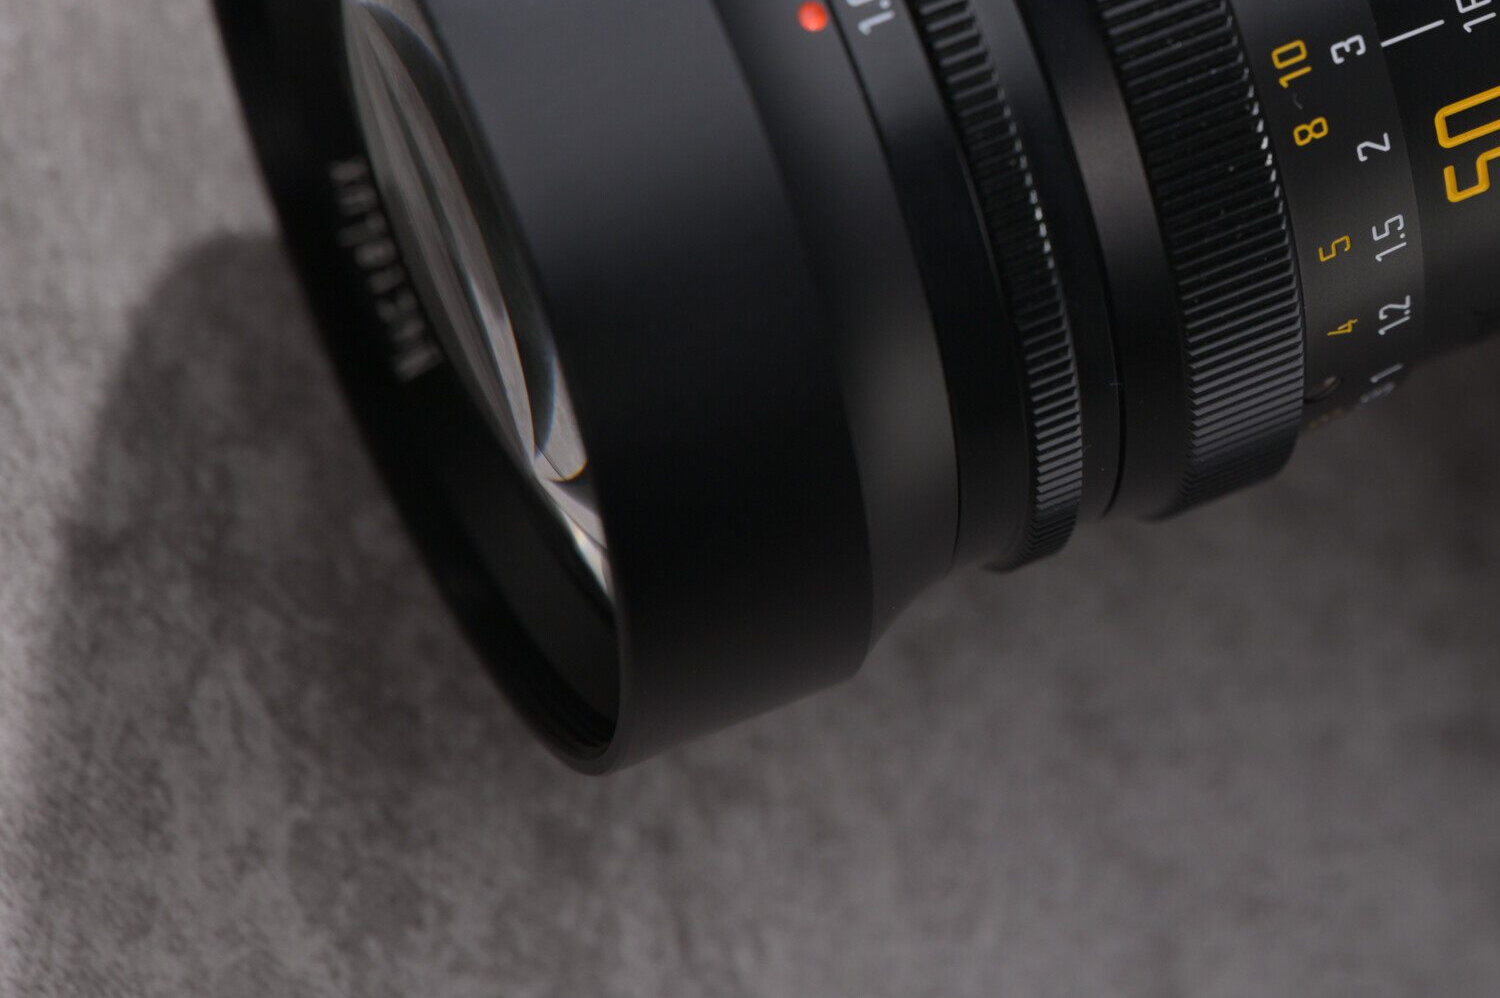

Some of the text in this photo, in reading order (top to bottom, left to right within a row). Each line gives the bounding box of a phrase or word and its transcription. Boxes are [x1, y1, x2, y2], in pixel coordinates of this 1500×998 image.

[1271, 39, 1312, 88] 10
[1330, 34, 1366, 64] 3
[1293, 117, 1329, 146] 8
[1356, 132, 1391, 162] 2
[1318, 235, 1352, 262] 5
[1371, 214, 1407, 262] 1.5
[1326, 318, 1359, 336] 4
[1377, 294, 1411, 336] 1.2
